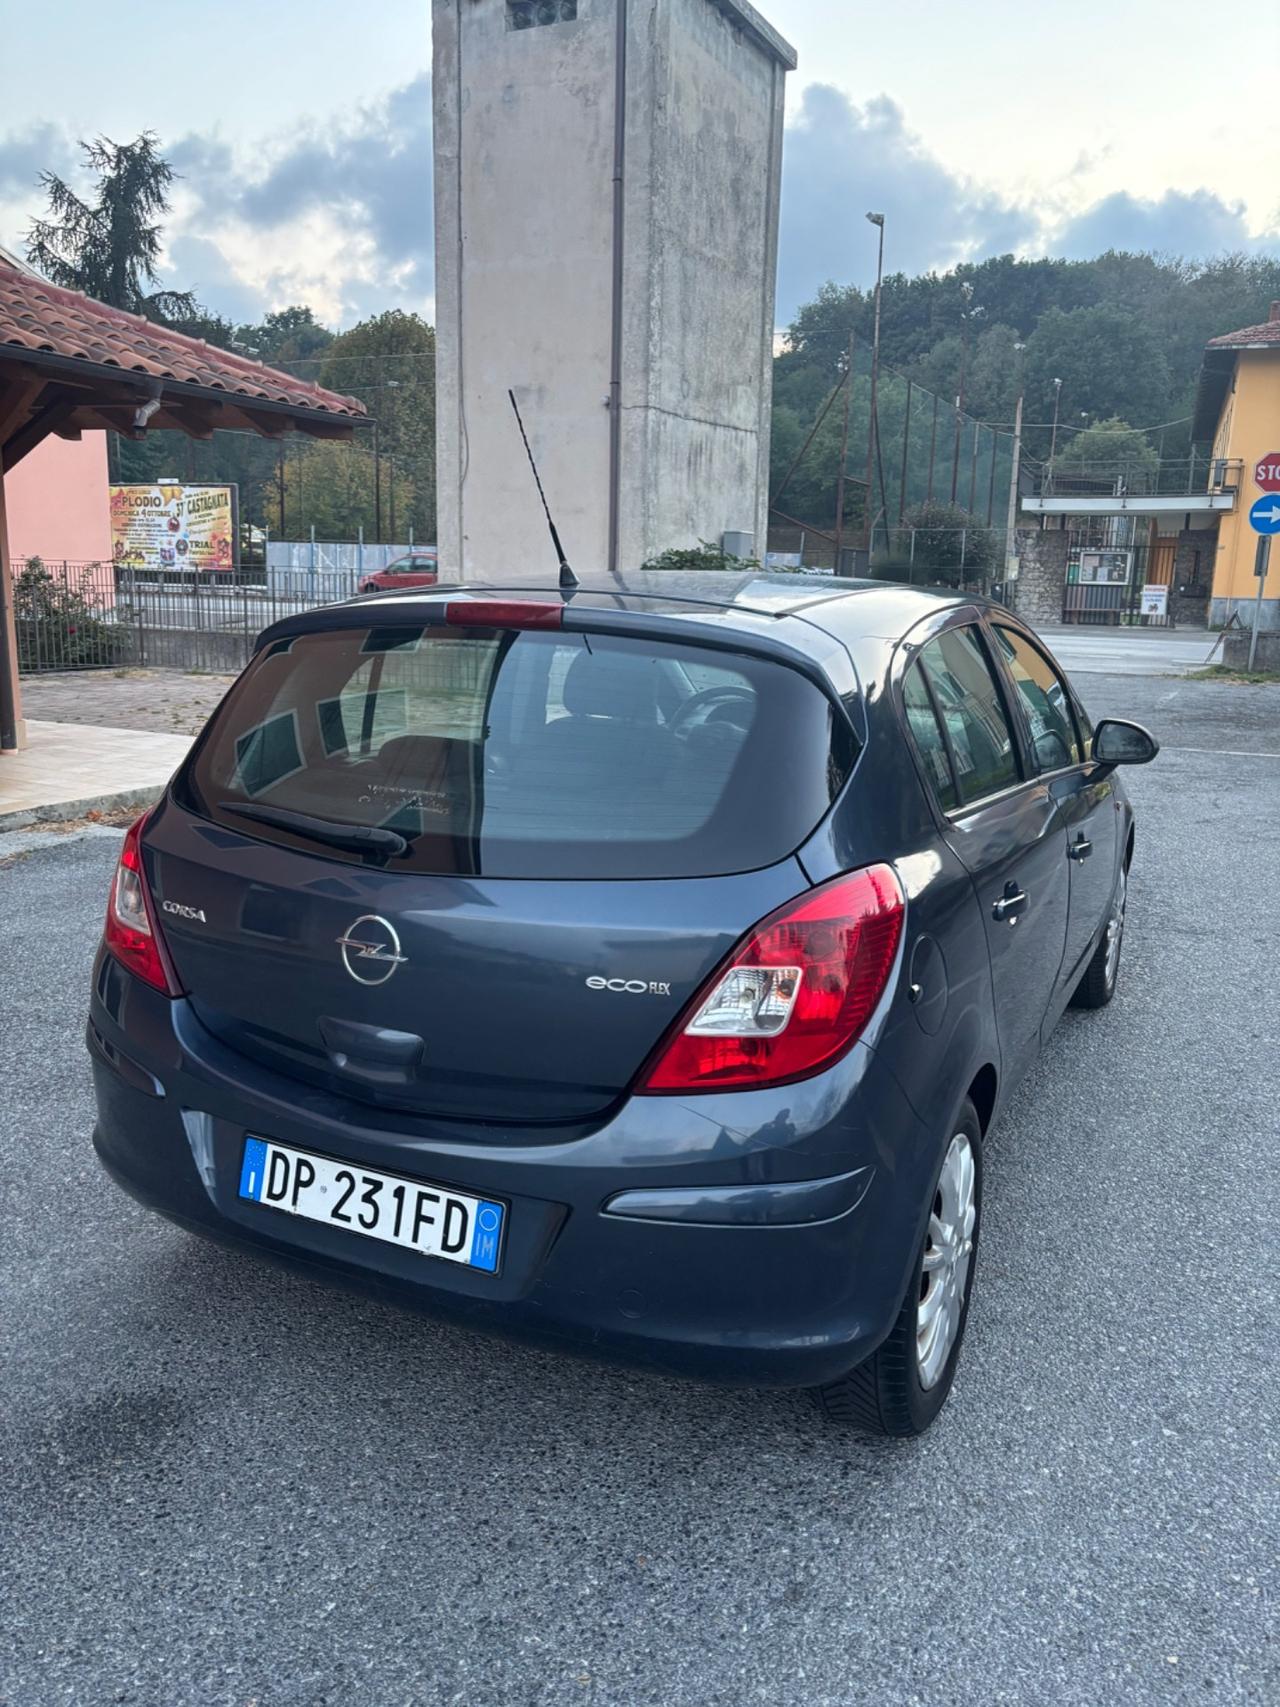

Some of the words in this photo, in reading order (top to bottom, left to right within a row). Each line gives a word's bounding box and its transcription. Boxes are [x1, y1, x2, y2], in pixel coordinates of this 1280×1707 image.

[122, 496, 162, 507] PLODIO
[189, 540, 216, 548] TRIAL
[162, 900, 207, 923] CORSA
